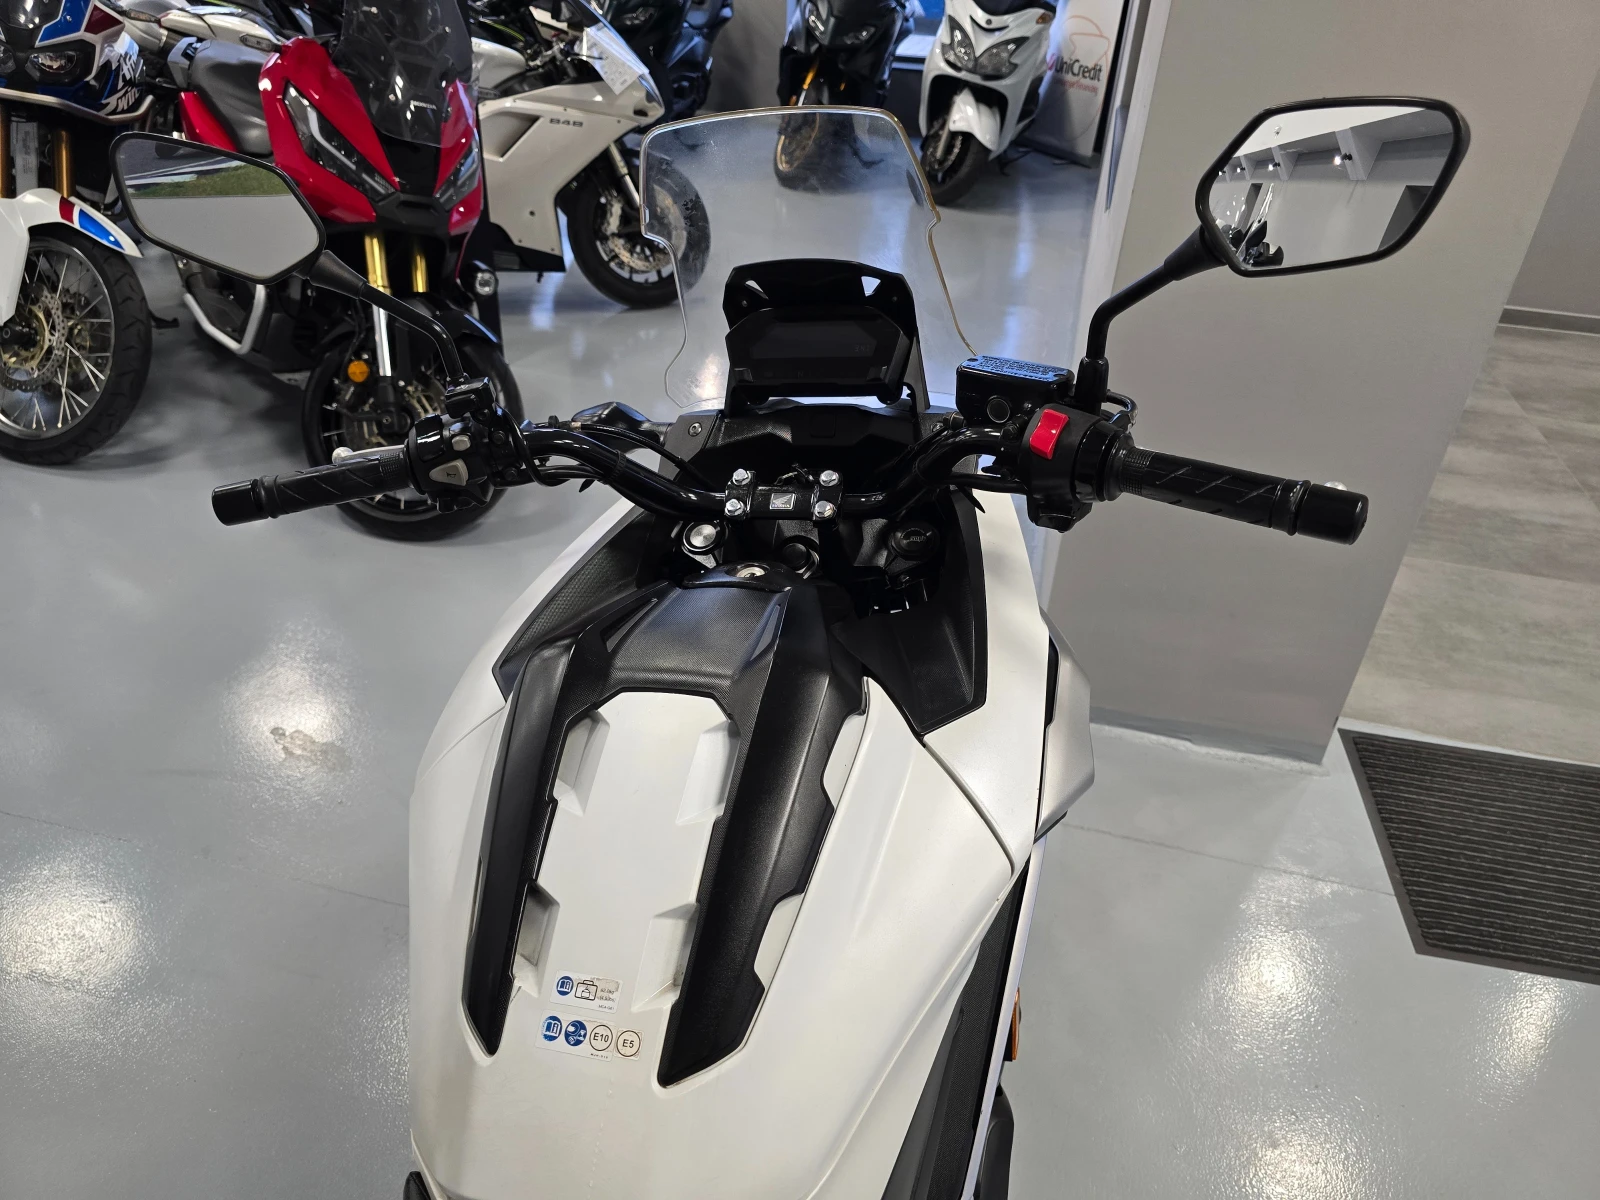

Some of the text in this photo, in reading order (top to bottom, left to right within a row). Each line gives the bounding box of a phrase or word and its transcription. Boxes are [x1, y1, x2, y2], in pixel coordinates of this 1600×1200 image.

[1055, 56, 1102, 82] UniCredit
[593, 1032, 610, 1043] E10
[622, 1039, 635, 1049] E5
